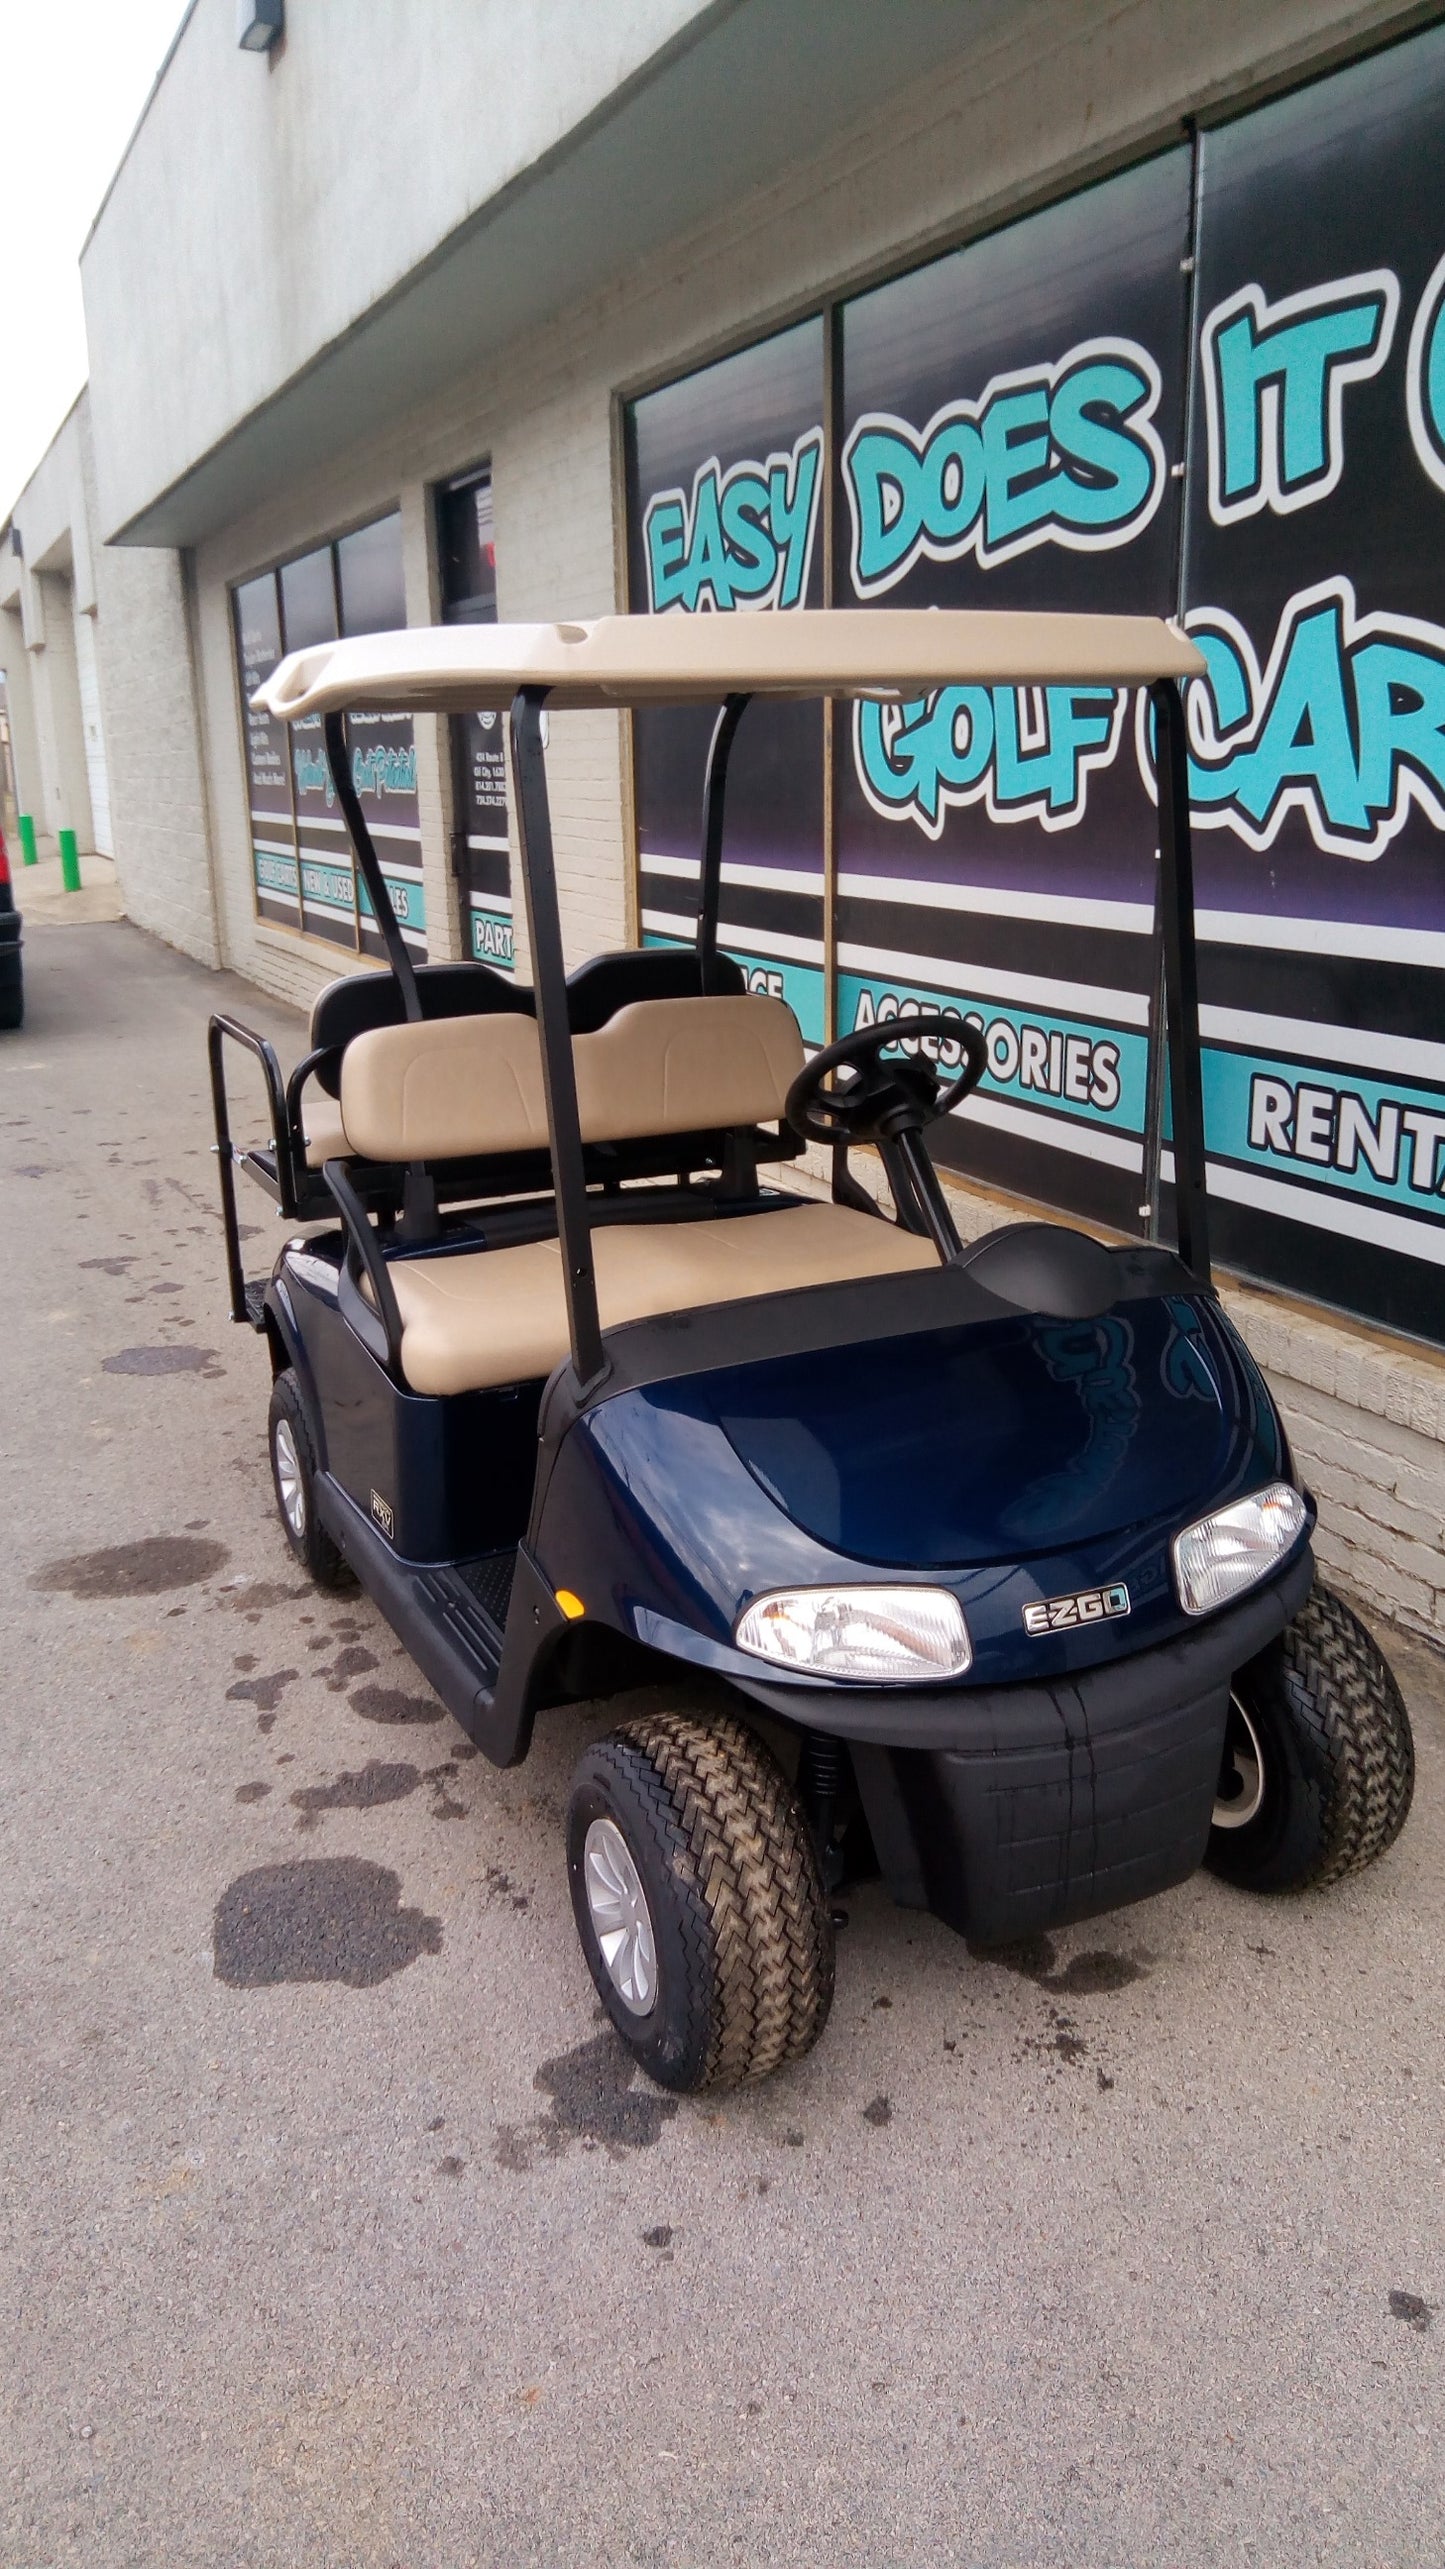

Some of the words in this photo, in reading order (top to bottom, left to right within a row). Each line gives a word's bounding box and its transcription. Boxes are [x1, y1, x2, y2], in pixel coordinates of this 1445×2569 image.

[643, 426, 825, 612] EASY
[842, 337, 1165, 598] DOES
[1203, 269, 1399, 526] IT
[853, 686, 1128, 841] GOLF
[303, 869, 321, 895] NEW
[323, 872, 330, 897] &
[332, 873, 354, 903] USED
[1248, 1072, 1445, 1199] RENT
